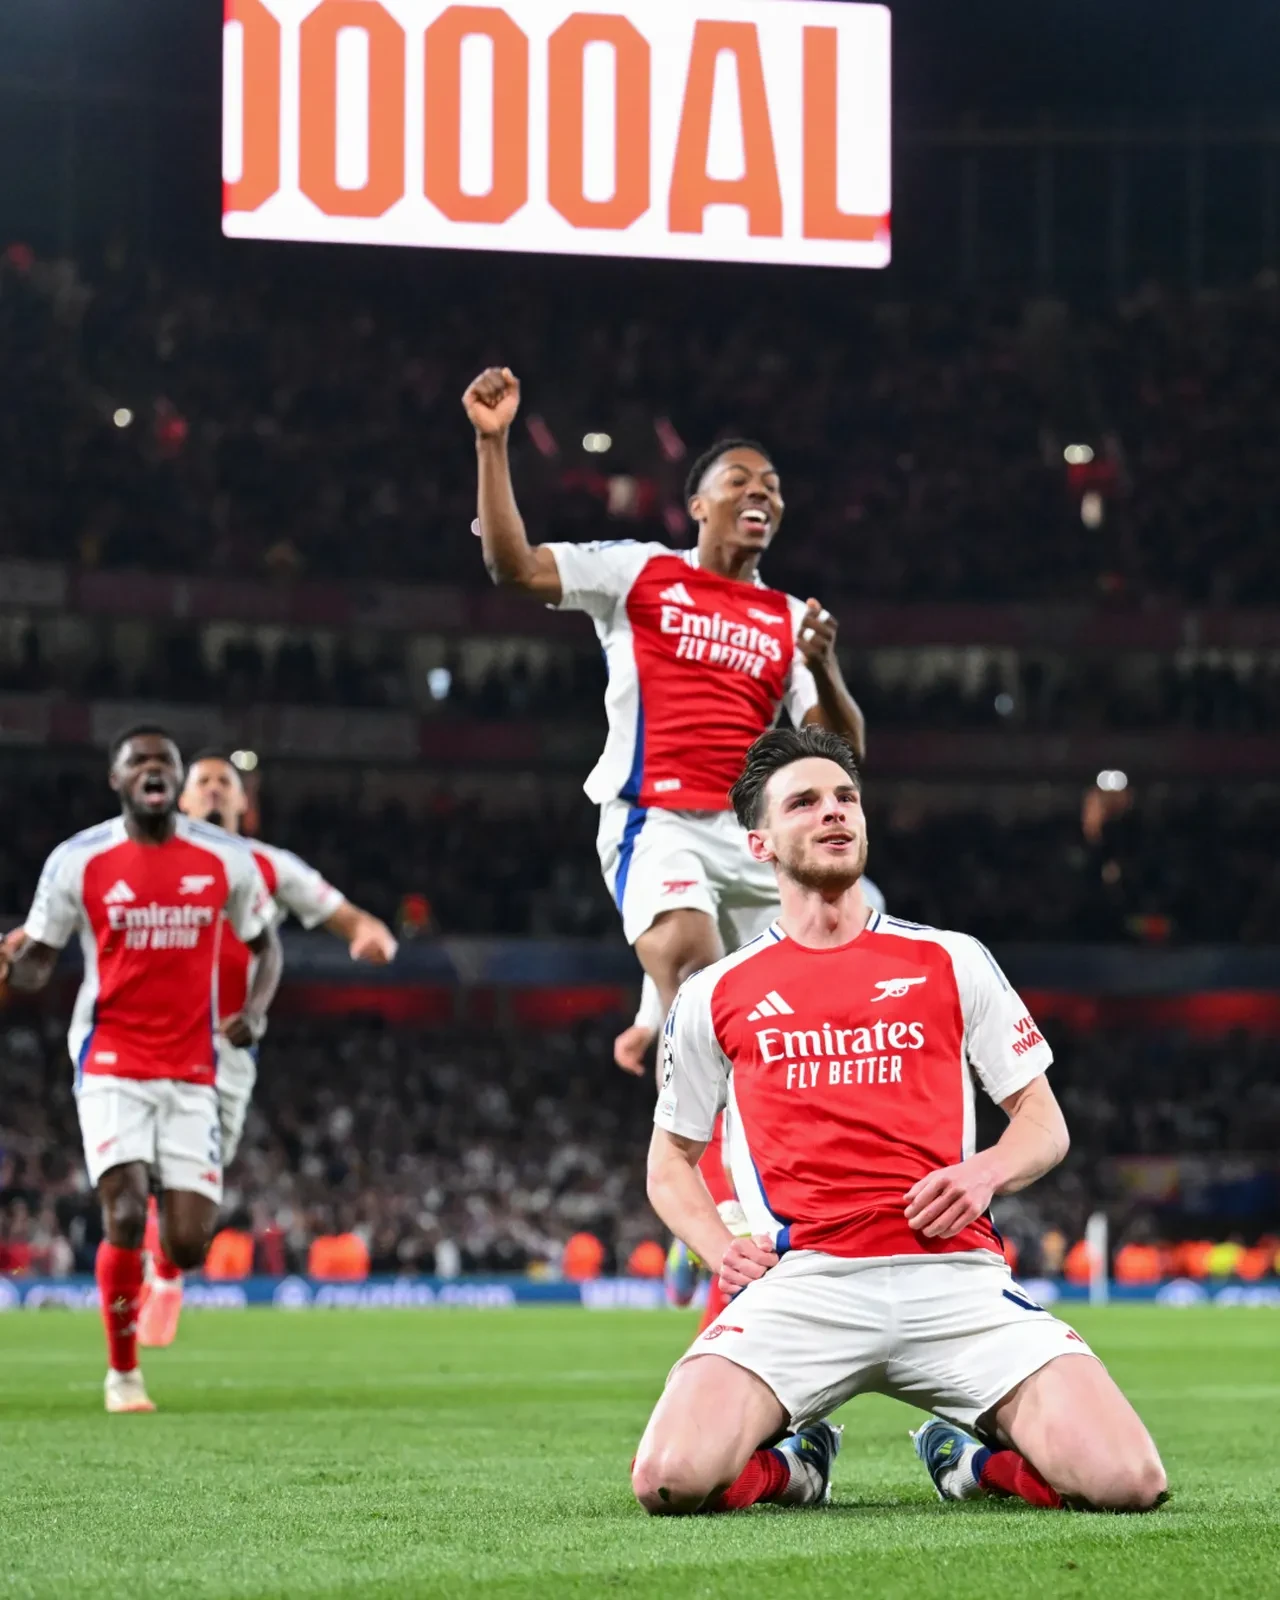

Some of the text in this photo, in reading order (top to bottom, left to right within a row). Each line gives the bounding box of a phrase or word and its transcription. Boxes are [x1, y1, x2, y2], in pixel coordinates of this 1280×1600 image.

[660, 605, 782, 662] Emirates
[676, 635, 766, 679] FLY BETTER
[755, 1018, 925, 1064] Emirates
[787, 1055, 902, 1090] FLY BETTER
